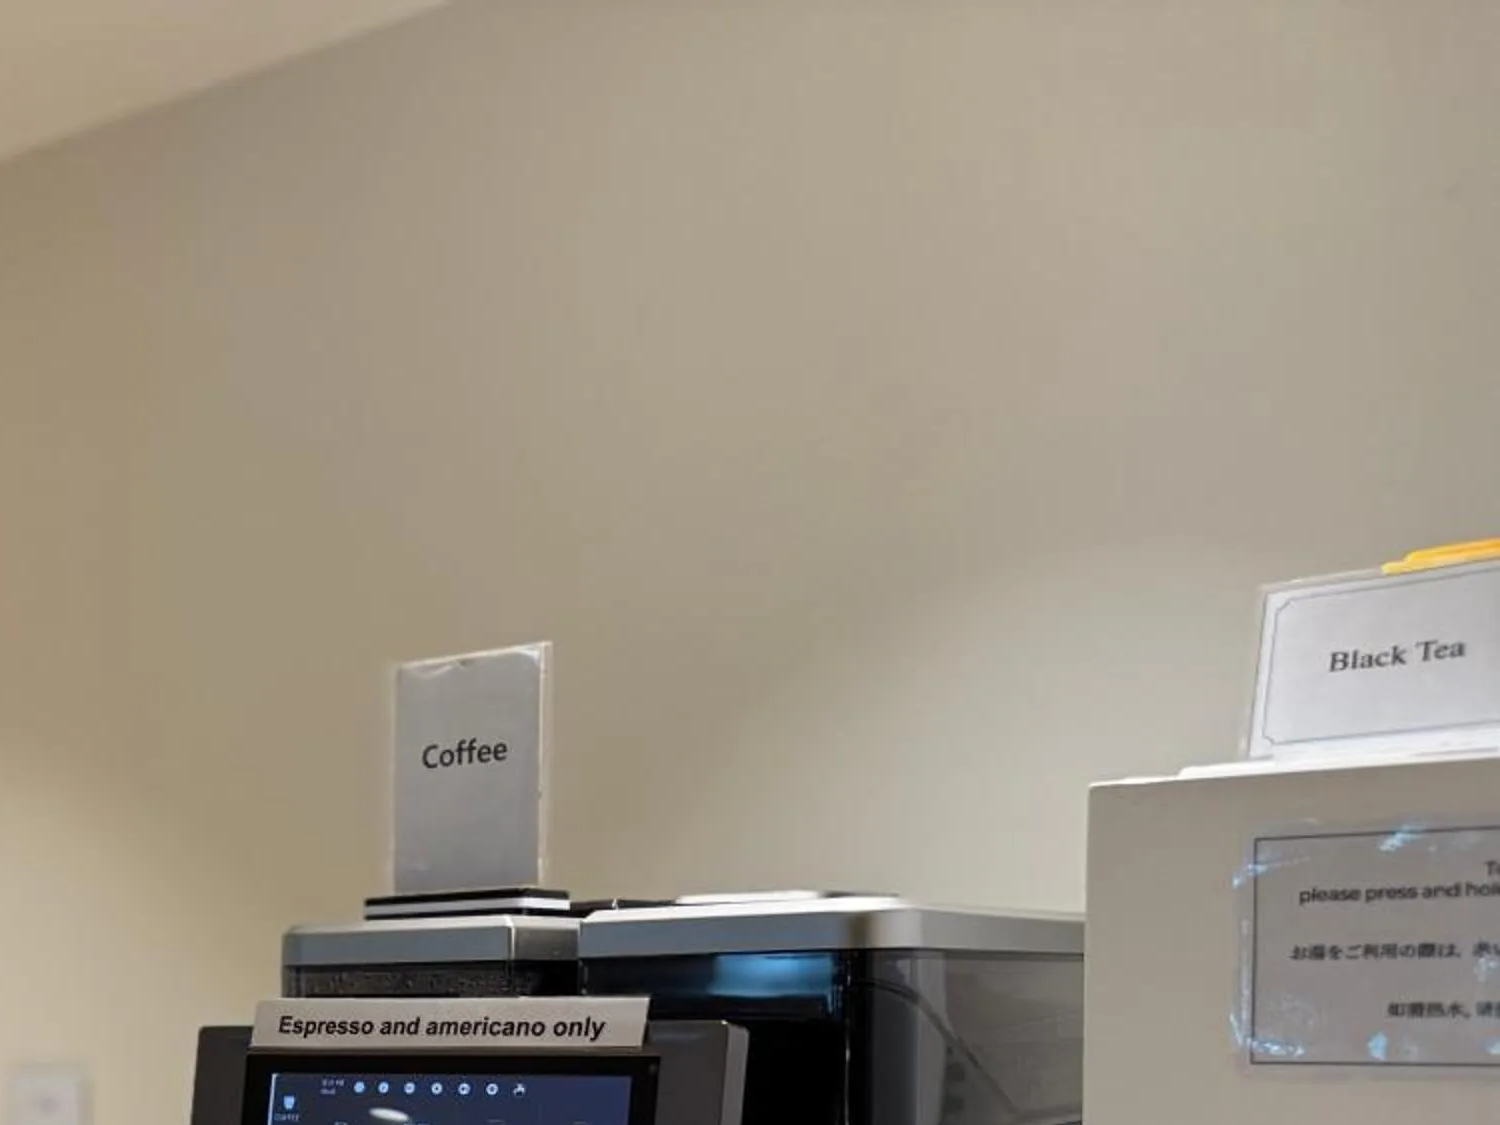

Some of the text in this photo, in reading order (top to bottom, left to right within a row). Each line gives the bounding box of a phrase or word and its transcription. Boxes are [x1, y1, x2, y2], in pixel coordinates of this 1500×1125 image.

[1329, 639, 1467, 673] Black Tea
[422, 737, 508, 769] Coffee
[1299, 885, 1361, 906] please
[1365, 885, 1419, 903] press
[1422, 881, 1461, 899] and
[278, 1015, 606, 1041] Espresso and americano only
